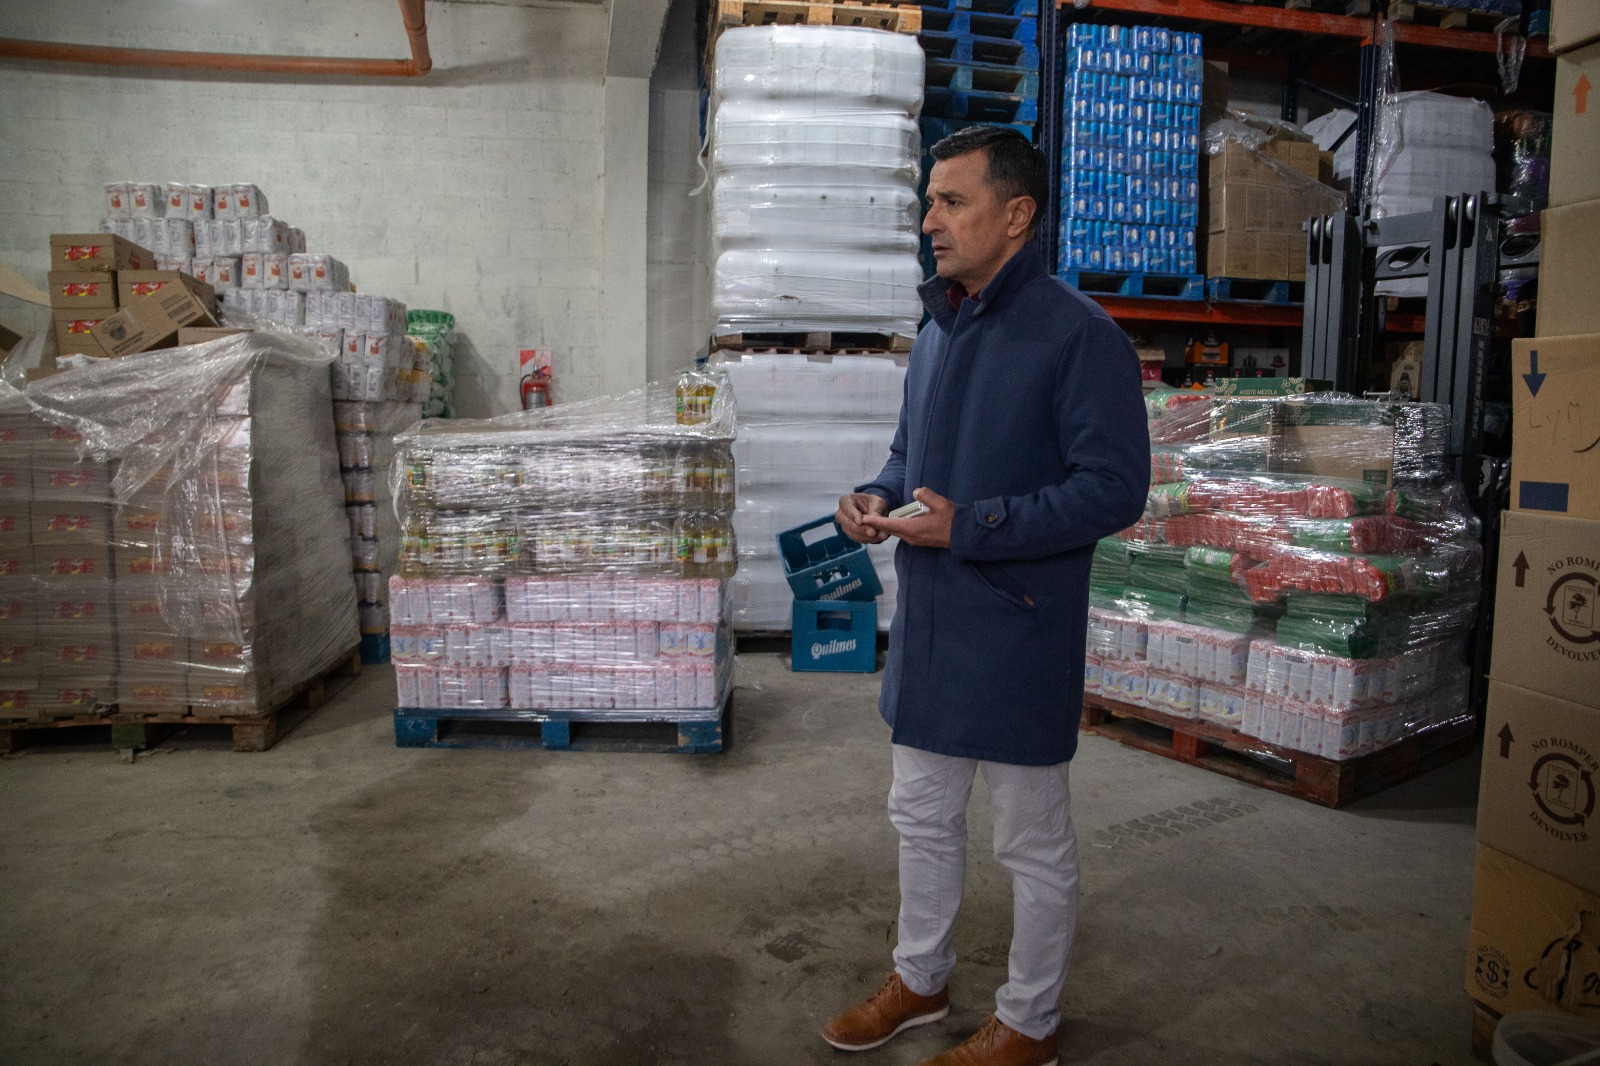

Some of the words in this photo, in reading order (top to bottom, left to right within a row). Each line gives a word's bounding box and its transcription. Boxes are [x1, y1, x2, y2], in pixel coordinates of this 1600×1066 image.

[1547, 560, 1564, 575] NO
[820, 577, 863, 601] Quilmes
[811, 638, 857, 660] Quilmes
[1531, 738, 1548, 752] NO
[1550, 737, 1600, 773] ROMPER
[1529, 810, 1590, 842] DEVOLVER
